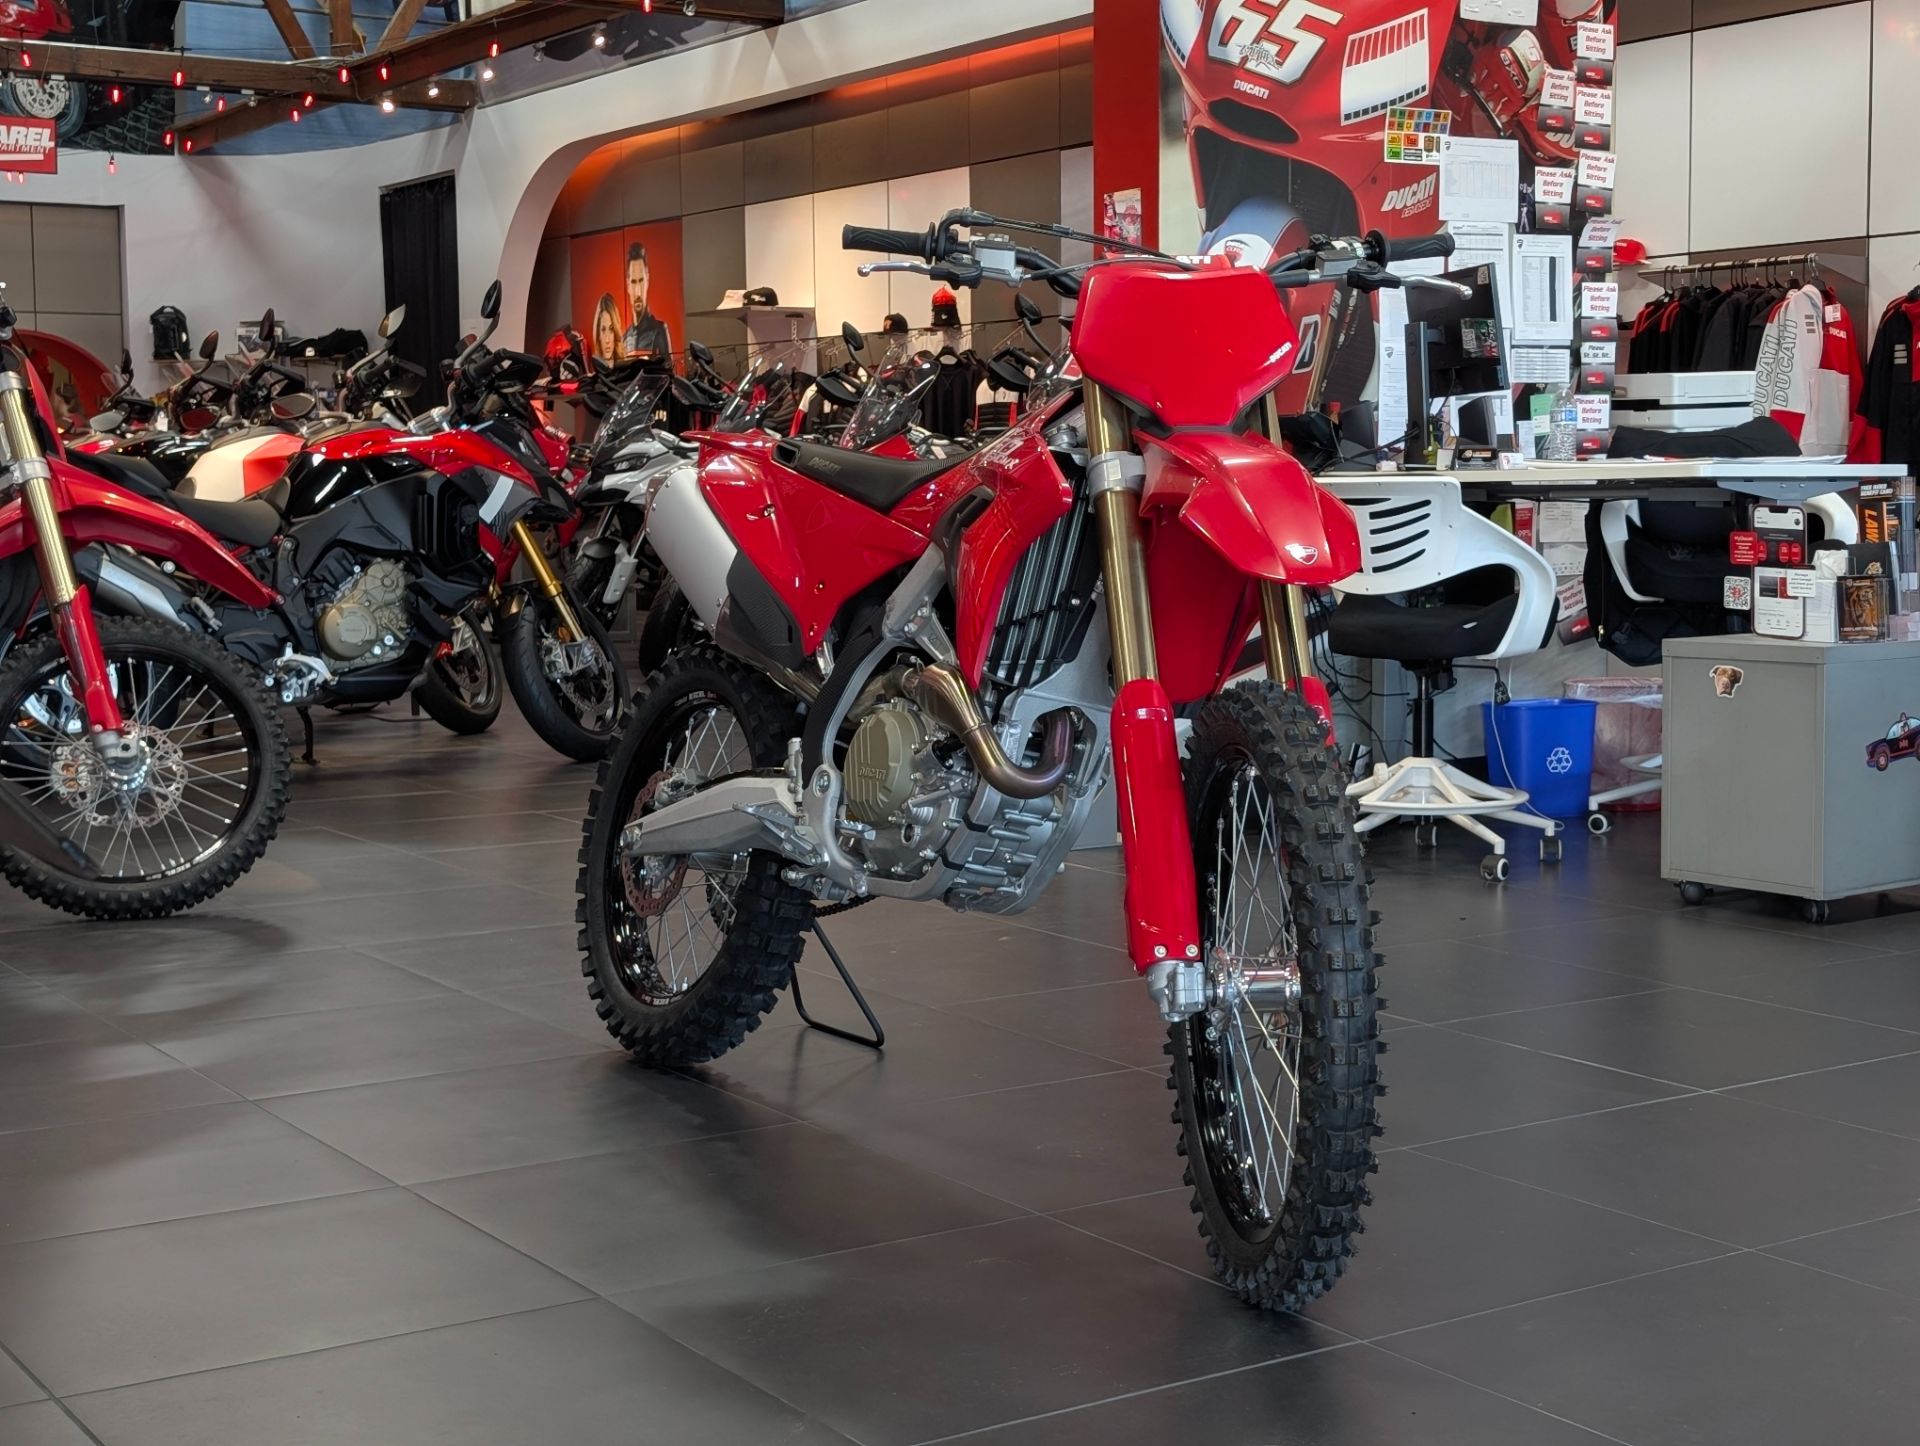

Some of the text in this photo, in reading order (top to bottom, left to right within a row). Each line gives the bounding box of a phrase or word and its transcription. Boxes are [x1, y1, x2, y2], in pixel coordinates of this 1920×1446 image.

[1579, 25, 1612, 35] Please Ask
[1208, 0, 1344, 85] 65
[1586, 35, 1606, 43] Before
[1585, 45, 1606, 54] Sitting
[1233, 80, 1269, 99] DUCATI
[1577, 90, 1610, 100] Please Ask
[1584, 101, 1604, 109] Before
[1584, 110, 1604, 120] Sitting
[1581, 153, 1601, 162] Please
[1587, 164, 1607, 172] Before
[1536, 170, 1557, 178] Please
[1586, 173, 1607, 183] Sitting
[1381, 172, 1437, 212] DUCATI
[1543, 190, 1563, 199] Sitting
[1773, 319, 1798, 408] DUCATI
[1752, 334, 1781, 418] DUCATI
